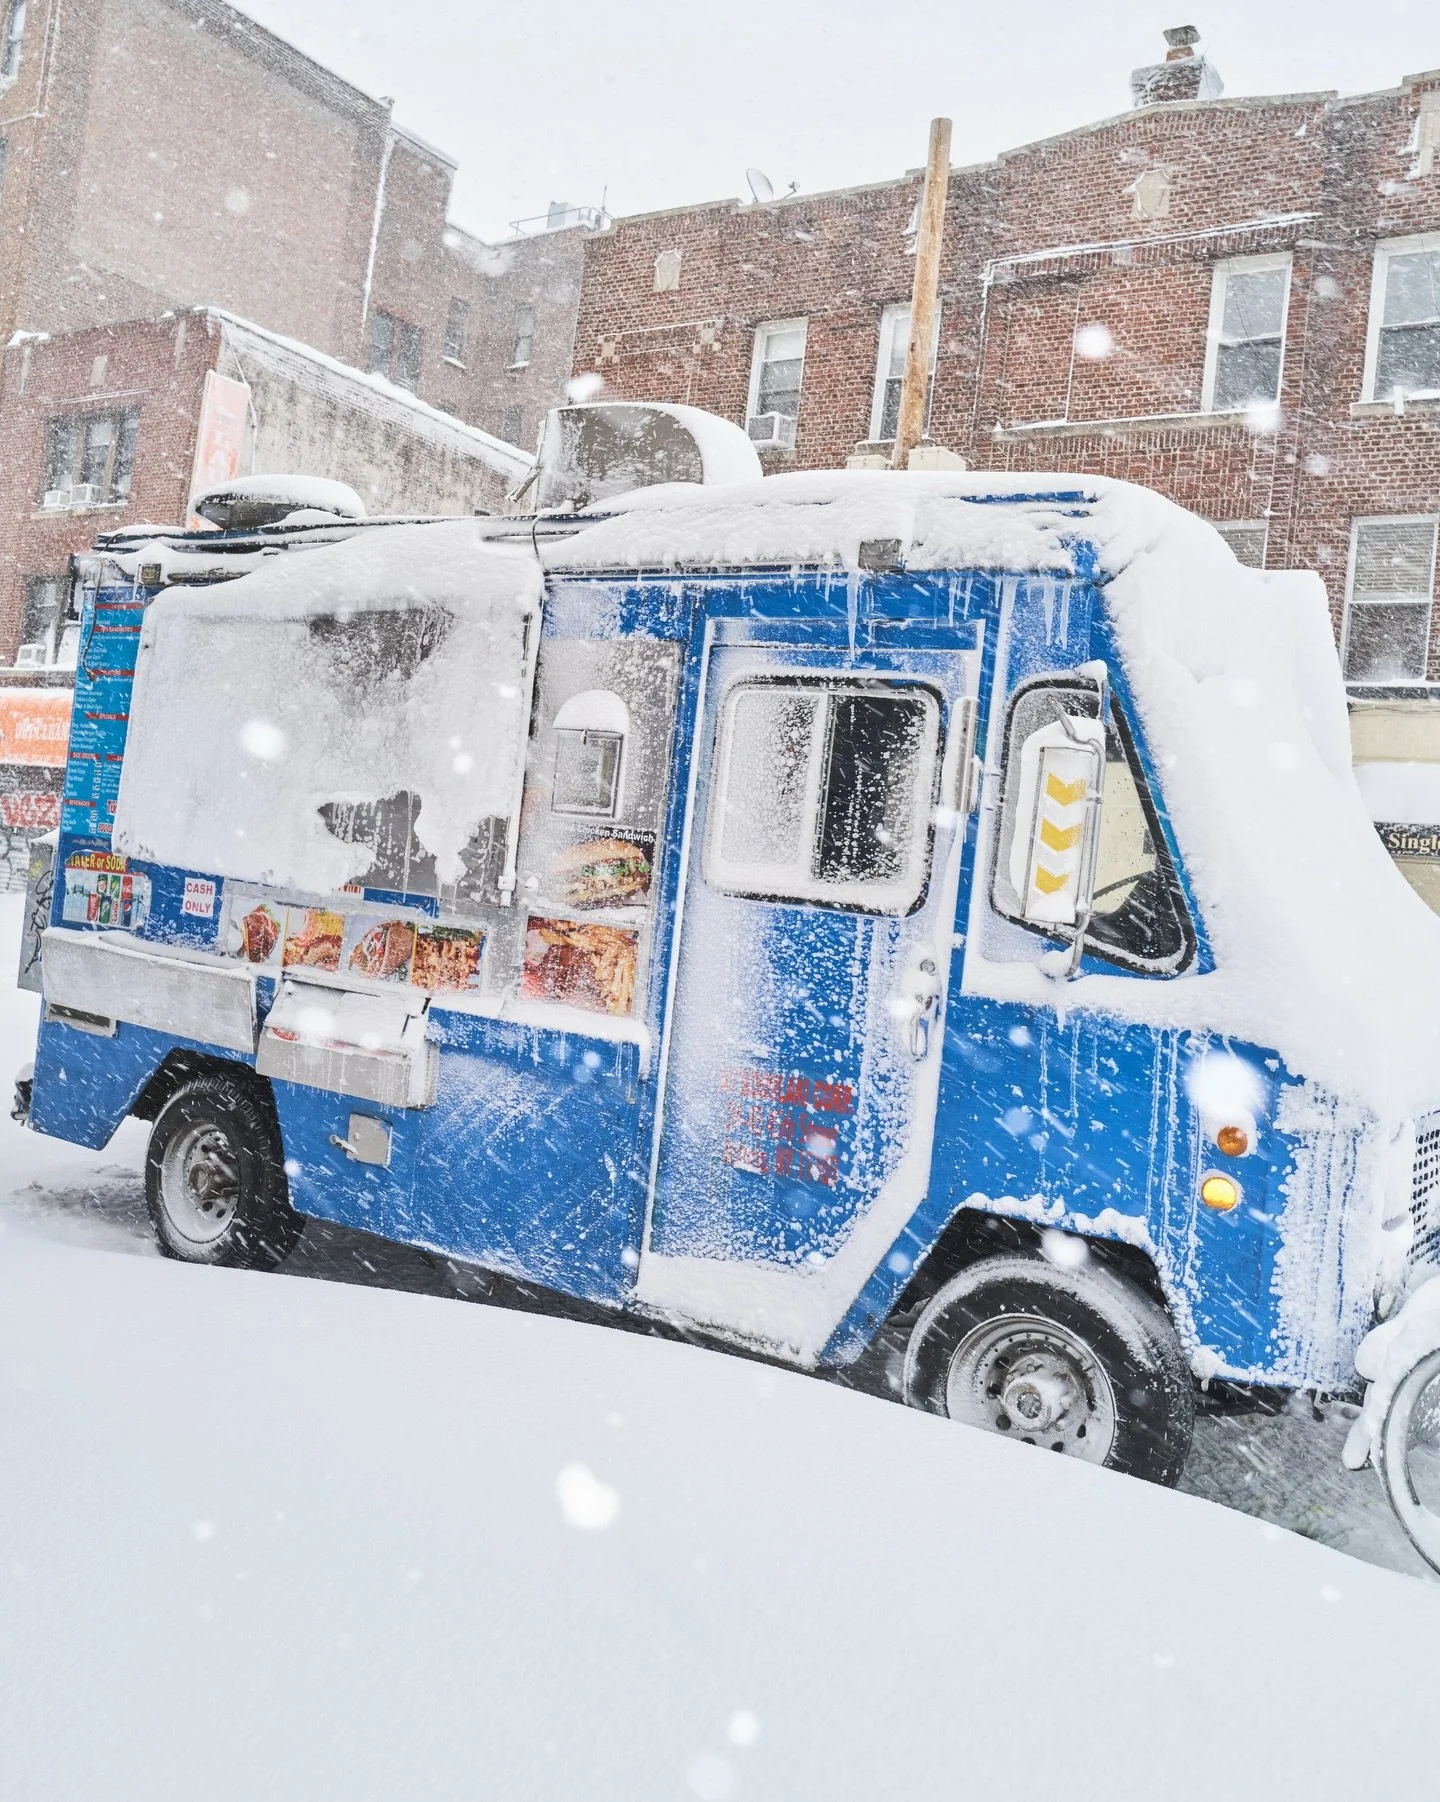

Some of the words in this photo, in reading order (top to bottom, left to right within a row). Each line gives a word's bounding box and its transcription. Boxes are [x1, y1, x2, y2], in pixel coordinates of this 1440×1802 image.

[610, 828, 655, 843] Sandwich
[96, 857, 105, 869] or
[105, 855, 127, 872] SODA
[186, 882, 213, 896] CASH
[185, 900, 211, 914] ONLY
